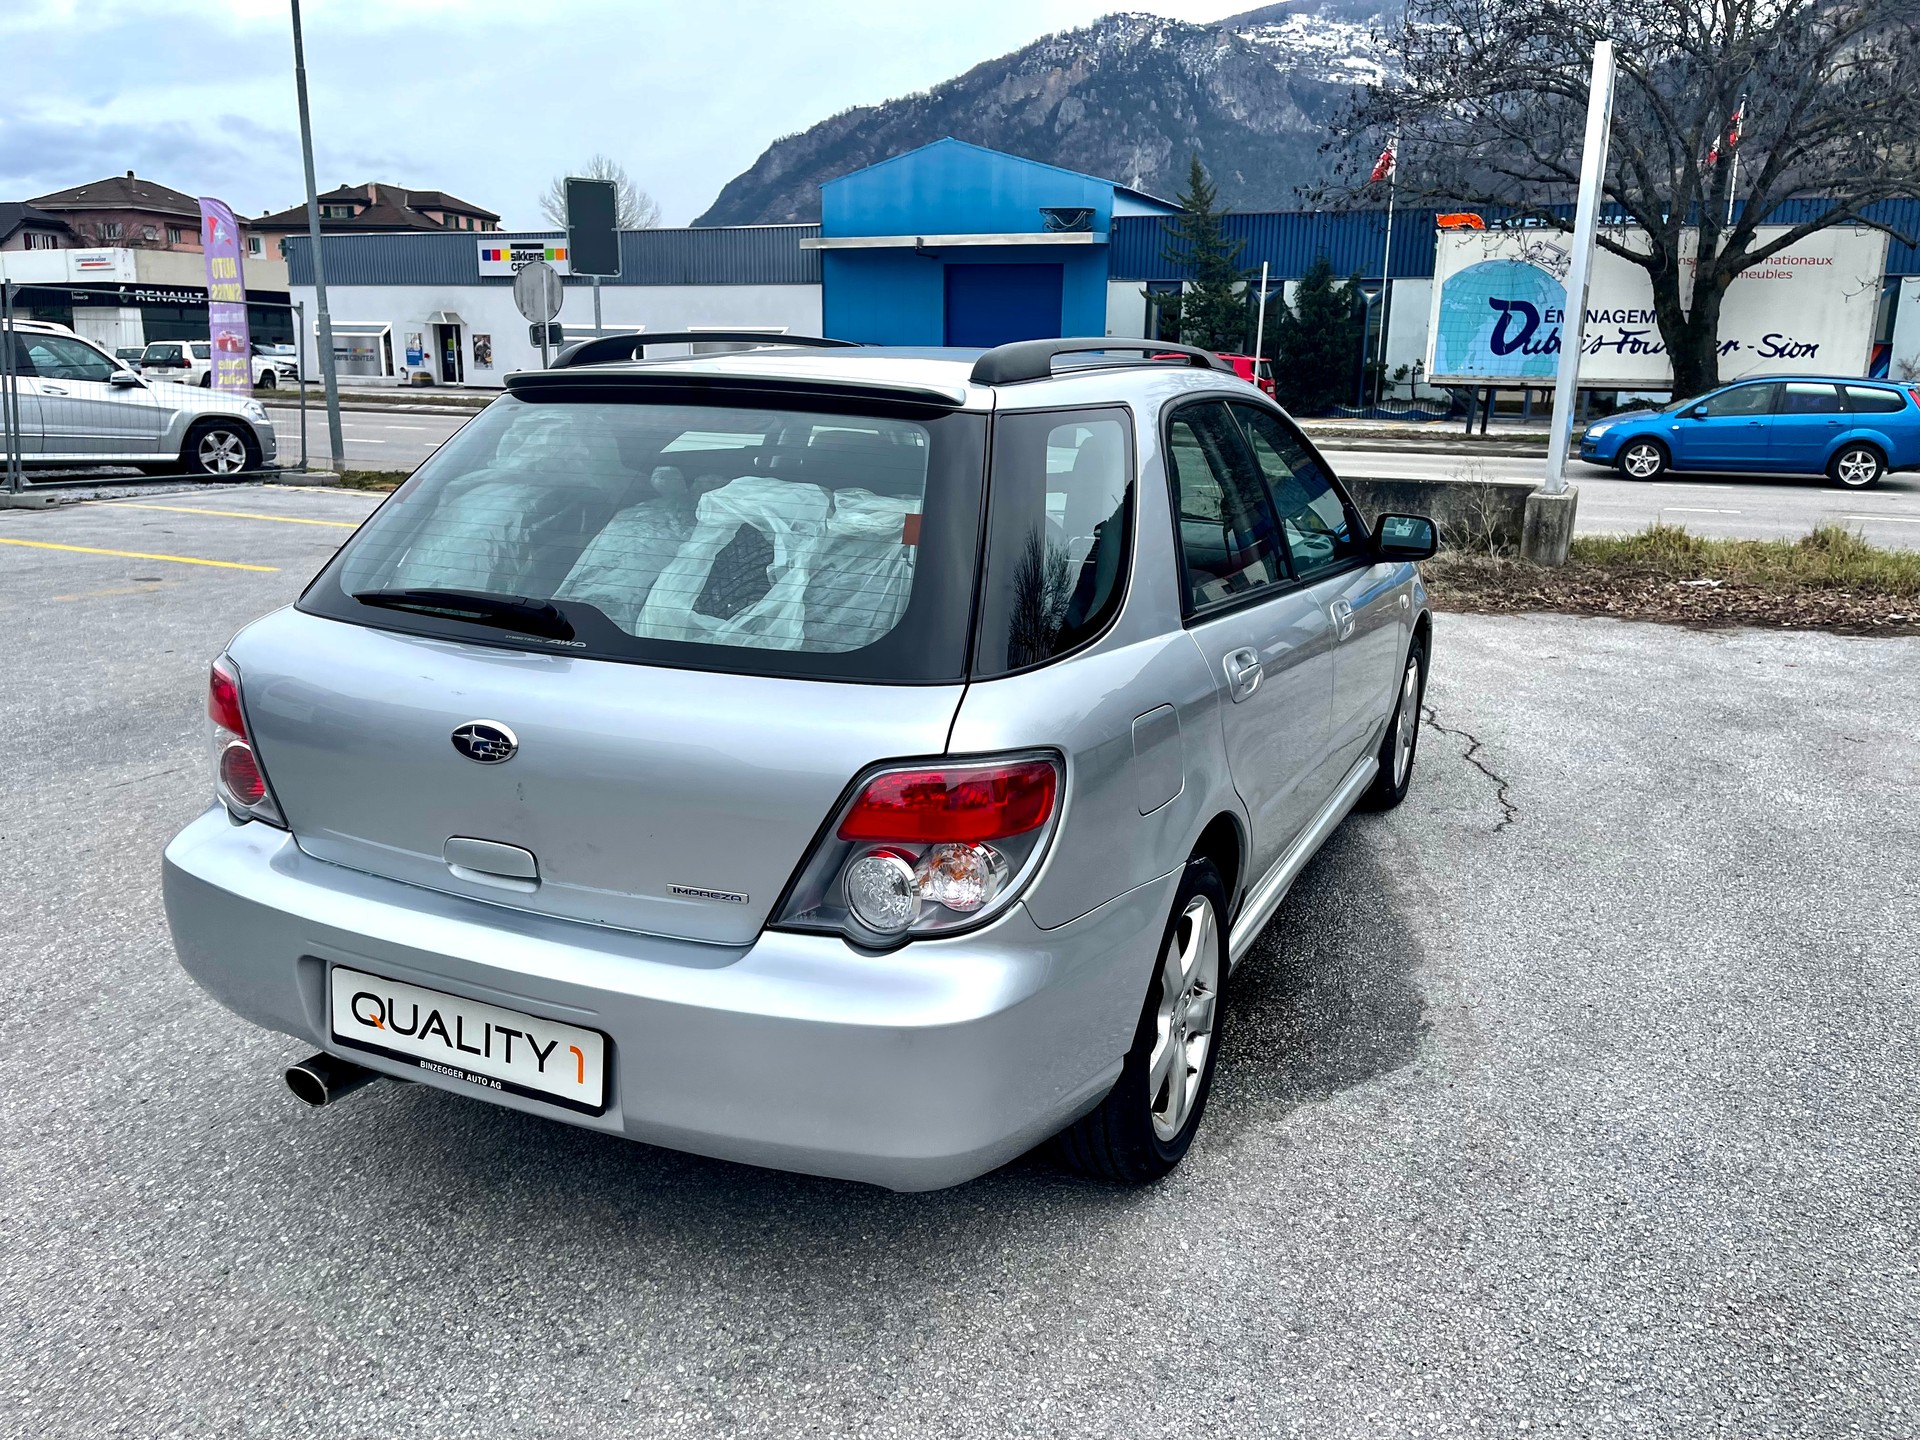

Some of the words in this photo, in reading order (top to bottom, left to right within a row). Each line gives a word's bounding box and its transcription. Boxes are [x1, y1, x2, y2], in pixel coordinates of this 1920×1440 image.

[510, 251, 545, 262] sikkens
[135, 289, 204, 304] RENAULT
[1757, 333, 1820, 359] Sion
[545, 639, 587, 648] AWD
[672, 887, 742, 902] IMPREZA
[351, 991, 559, 1073] QUALITY
[420, 1060, 464, 1079] BINZEGGER
[466, 1073, 488, 1086] AUTO
[489, 1080, 502, 1090] AG
